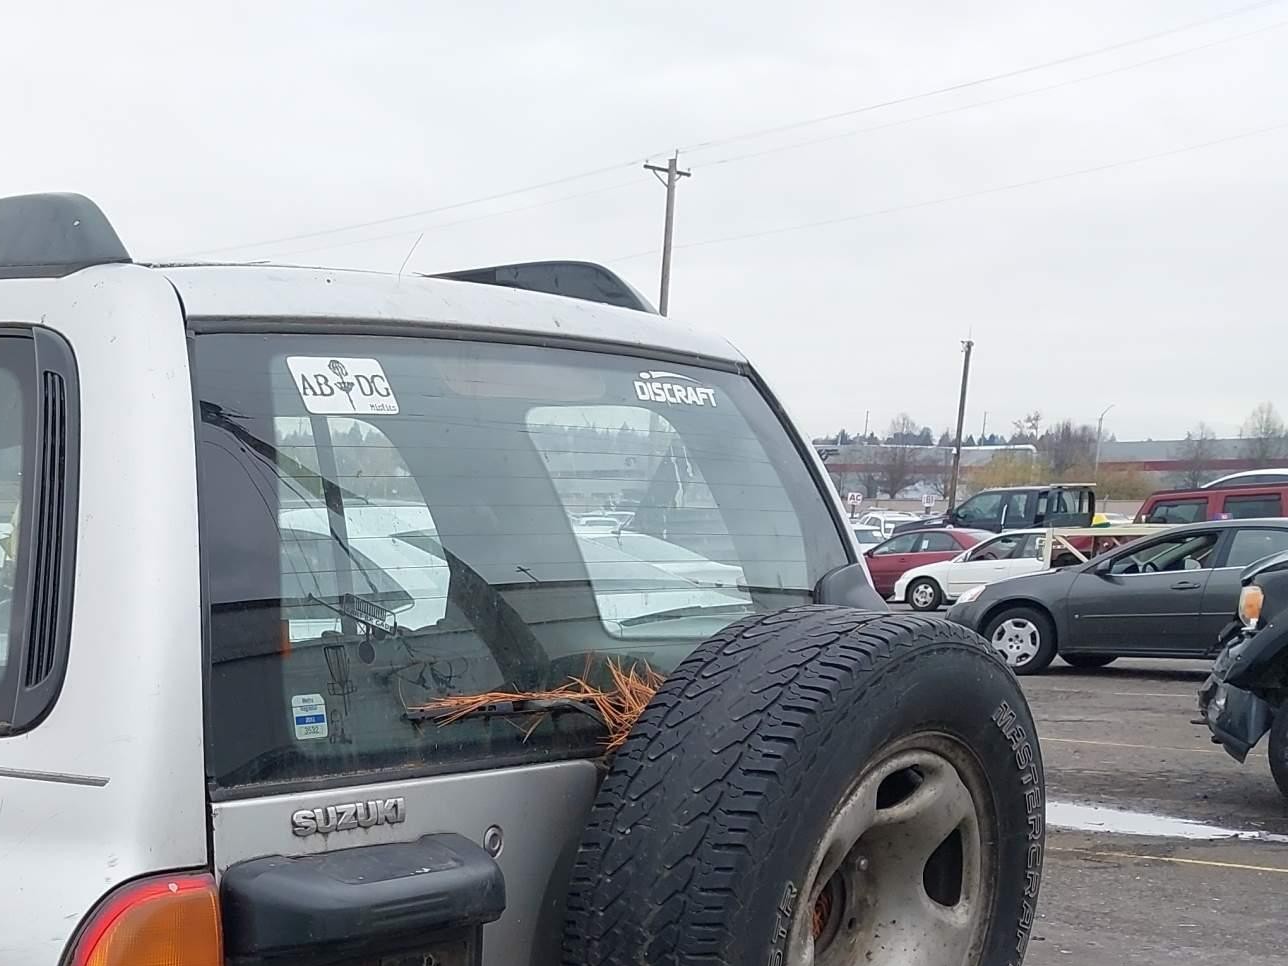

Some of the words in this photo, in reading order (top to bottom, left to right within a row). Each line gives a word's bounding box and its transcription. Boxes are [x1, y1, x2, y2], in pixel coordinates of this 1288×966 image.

[301, 374, 335, 397] AB
[353, 374, 391, 397] DG
[633, 380, 717, 407] DISCRAFT
[849, 494, 862, 502] AC
[292, 797, 405, 837] SUZUKI
